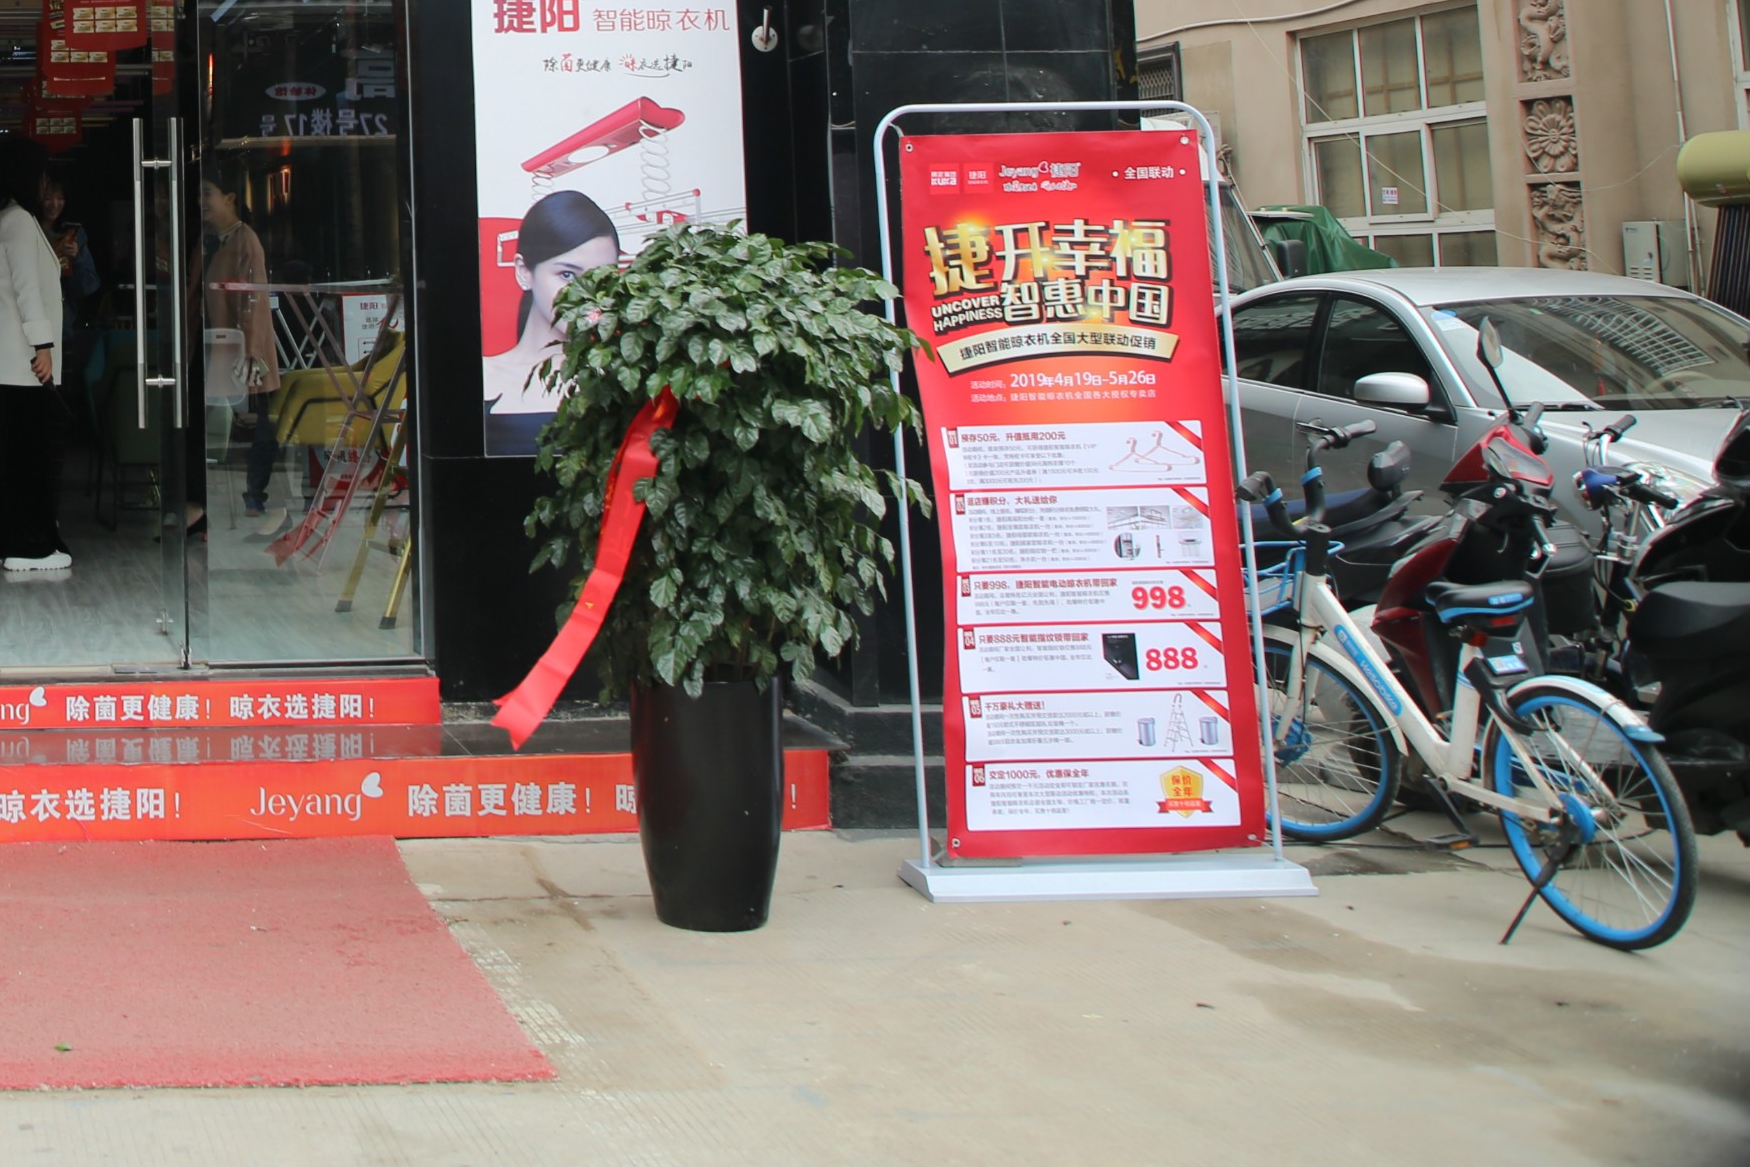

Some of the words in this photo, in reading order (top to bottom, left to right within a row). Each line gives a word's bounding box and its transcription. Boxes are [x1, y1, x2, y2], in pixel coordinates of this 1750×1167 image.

[592, 8, 731, 32] 智能晾衣机
[1123, 165, 1174, 180] 全国联动
[924, 218, 1171, 298] 捷开幸福
[931, 294, 1001, 319] UNCOVER
[1000, 276, 1173, 326] 智惠中国
[933, 307, 1003, 332] HAPPINESS
[959, 331, 1157, 361] 捷阳智能晾衣机全国大型联动促销
[1131, 585, 1187, 610] 998
[1146, 646, 1199, 671] 888
[249, 786, 363, 821] Jeyang
